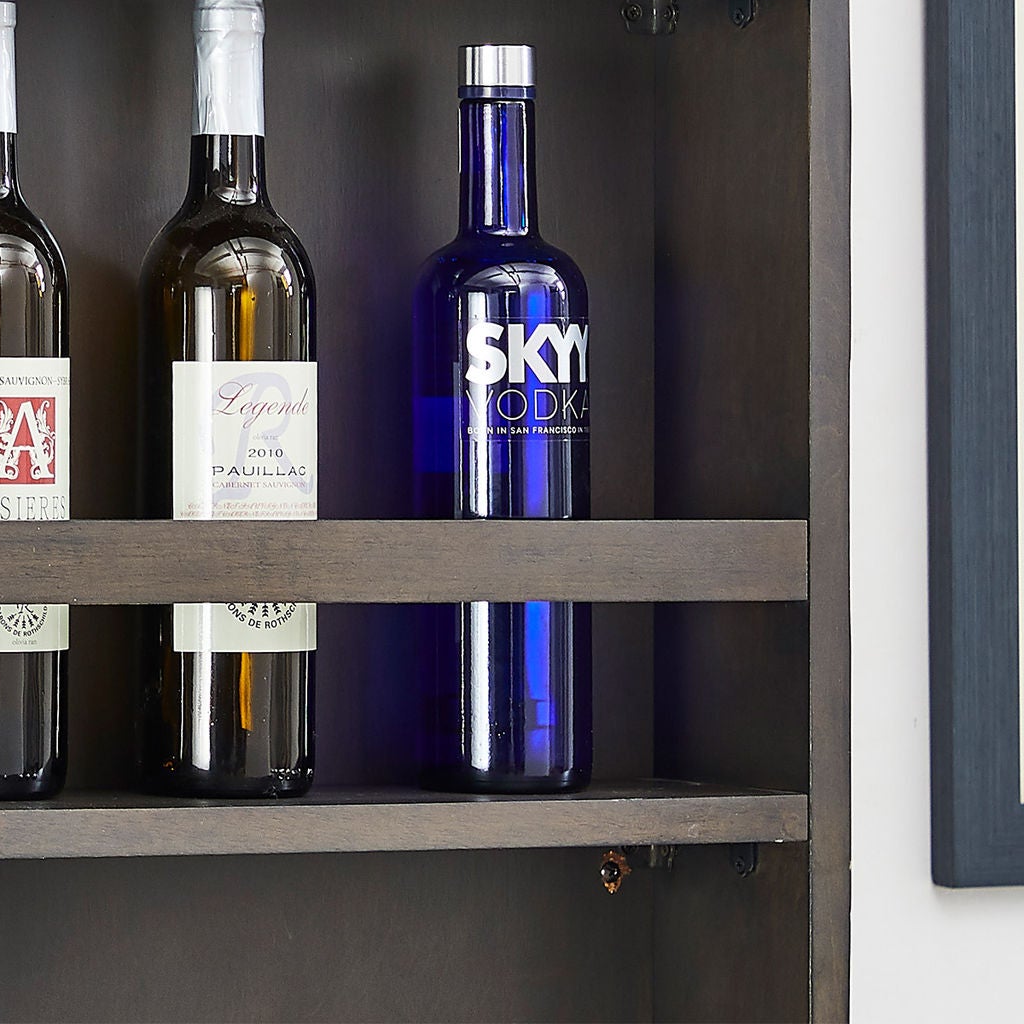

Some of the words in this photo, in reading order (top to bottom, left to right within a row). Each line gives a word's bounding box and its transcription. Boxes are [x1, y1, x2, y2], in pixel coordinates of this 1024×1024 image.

[465, 322, 589, 385] SKYY
[214, 381, 310, 430] Legende
[467, 426, 493, 435] BON
[496, 426, 507, 435] IN
[510, 426, 529, 435] SAN
[532, 426, 577, 435] FRANCISCO
[248, 448, 284, 458] 2010
[212, 466, 306, 476] PAUILLAC
[212, 481, 259, 489] CABERNET
[262, 481, 306, 489] SAUVIGNON
[248, 618, 261, 629] DE
[12, 629, 21, 637] DE
